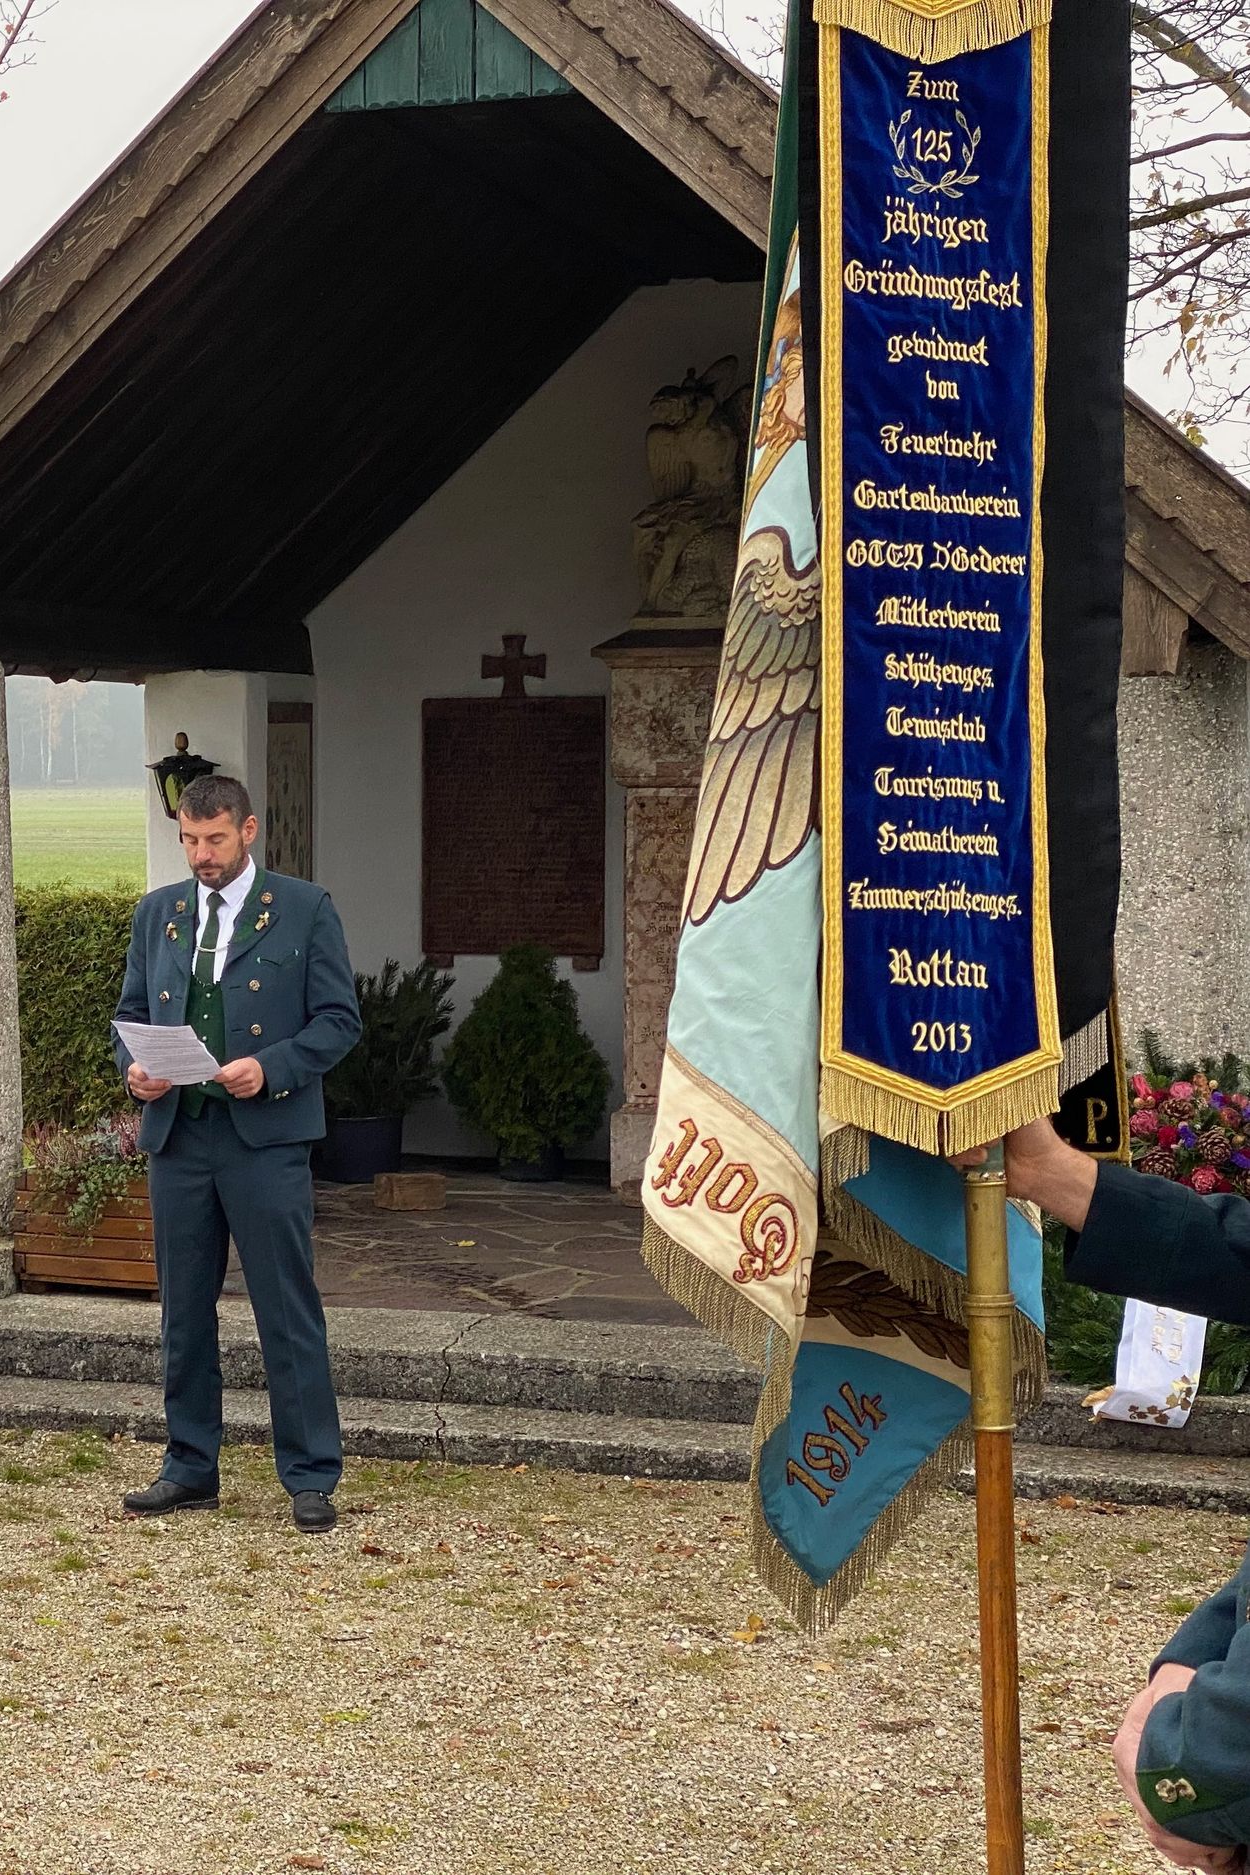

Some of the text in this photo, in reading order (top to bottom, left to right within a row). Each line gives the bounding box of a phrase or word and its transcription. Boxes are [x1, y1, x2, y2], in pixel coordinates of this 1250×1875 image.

[906, 71, 959, 102] Zum
[911, 127, 953, 162] 125
[881, 195, 989, 248] jährigen
[844, 259, 1023, 311] Gründungsfest
[887, 327, 989, 366] gewidmet
[925, 370, 959, 400] von
[880, 422, 998, 467] Feuerwehr
[853, 480, 1021, 518] Gartenbauverein
[875, 596, 1001, 632] Mütterverein
[884, 652, 994, 693] Schützenges.
[886, 706, 986, 745] Tennisclub
[874, 766, 1005, 806] Tourismus u.
[877, 820, 999, 856] Heimatverein
[848, 877, 1022, 921] Zimmerschützenges.
[888, 948, 989, 989] Rottau
[911, 1021, 972, 1053] 2013
[785, 1381, 888, 1508] 1914
